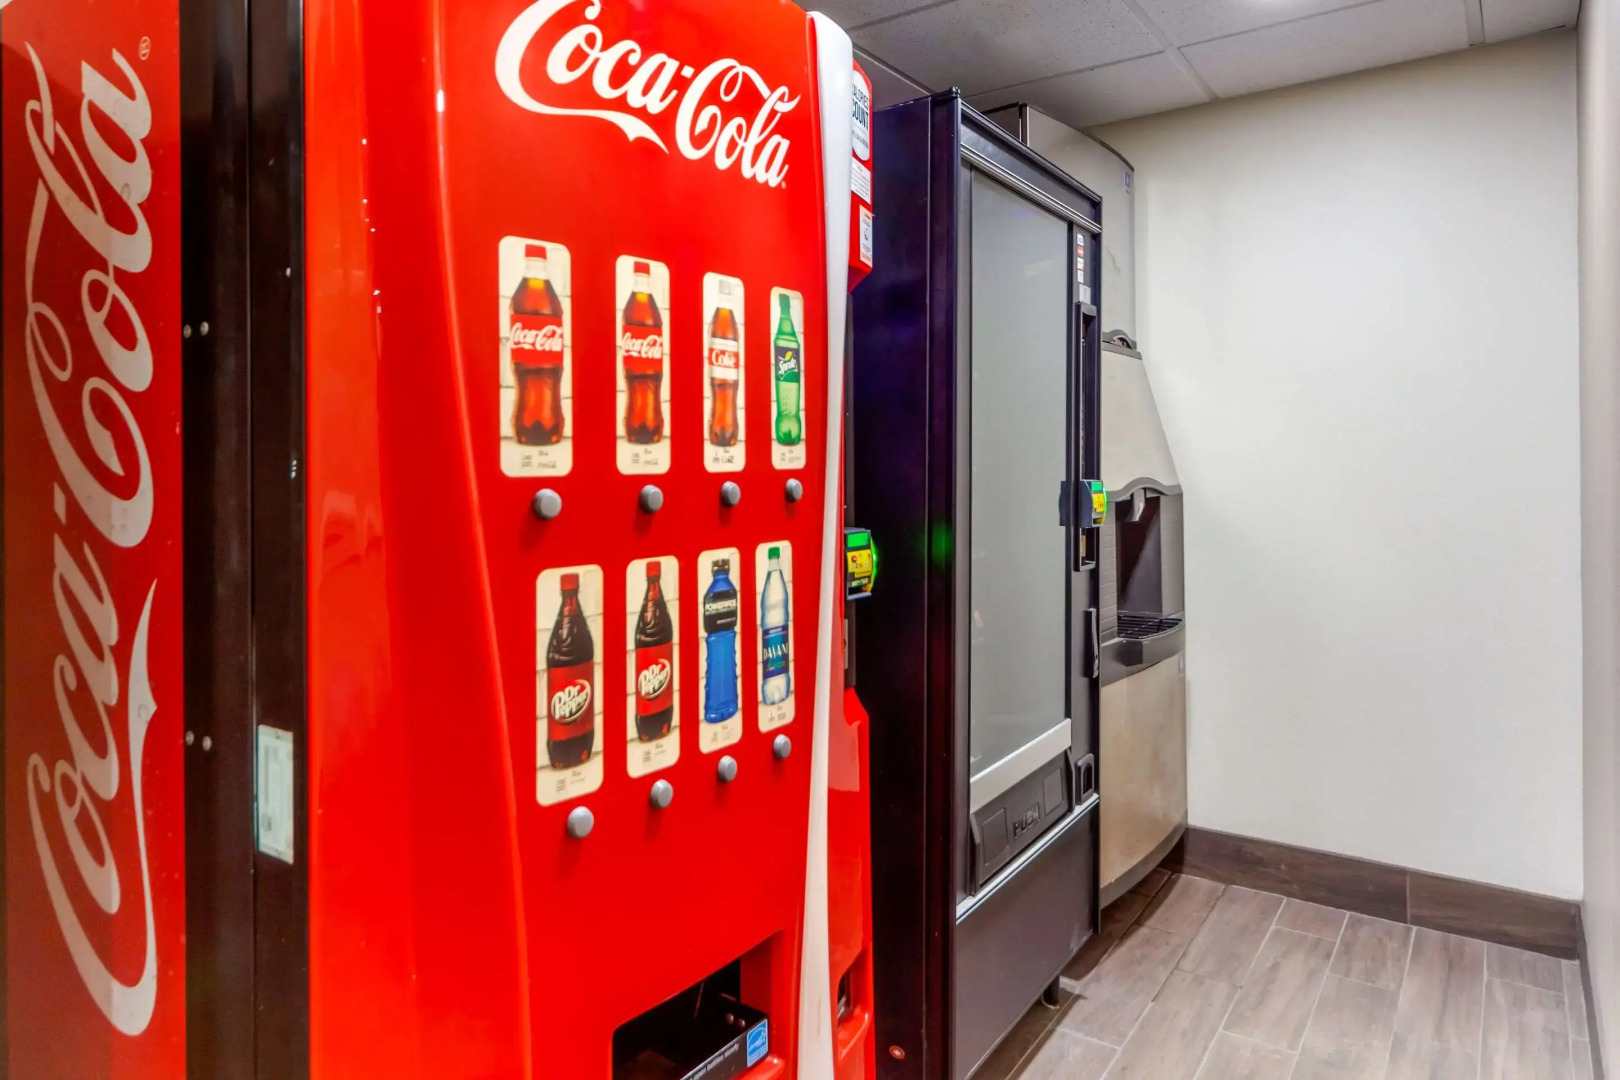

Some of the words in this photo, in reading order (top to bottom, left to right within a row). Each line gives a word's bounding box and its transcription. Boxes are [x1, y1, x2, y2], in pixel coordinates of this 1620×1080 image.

[495, 0, 801, 188] Coca-Cola
[510, 321, 563, 352] Coca-Cola
[621, 332, 663, 359] Coca-Cola
[778, 357, 797, 376] Sprite
[24, 40, 157, 1036] Coca-Cola
[648, 663, 662, 678] Dr
[551, 689, 588, 721] Pepper
[563, 684, 581, 701] Dr
